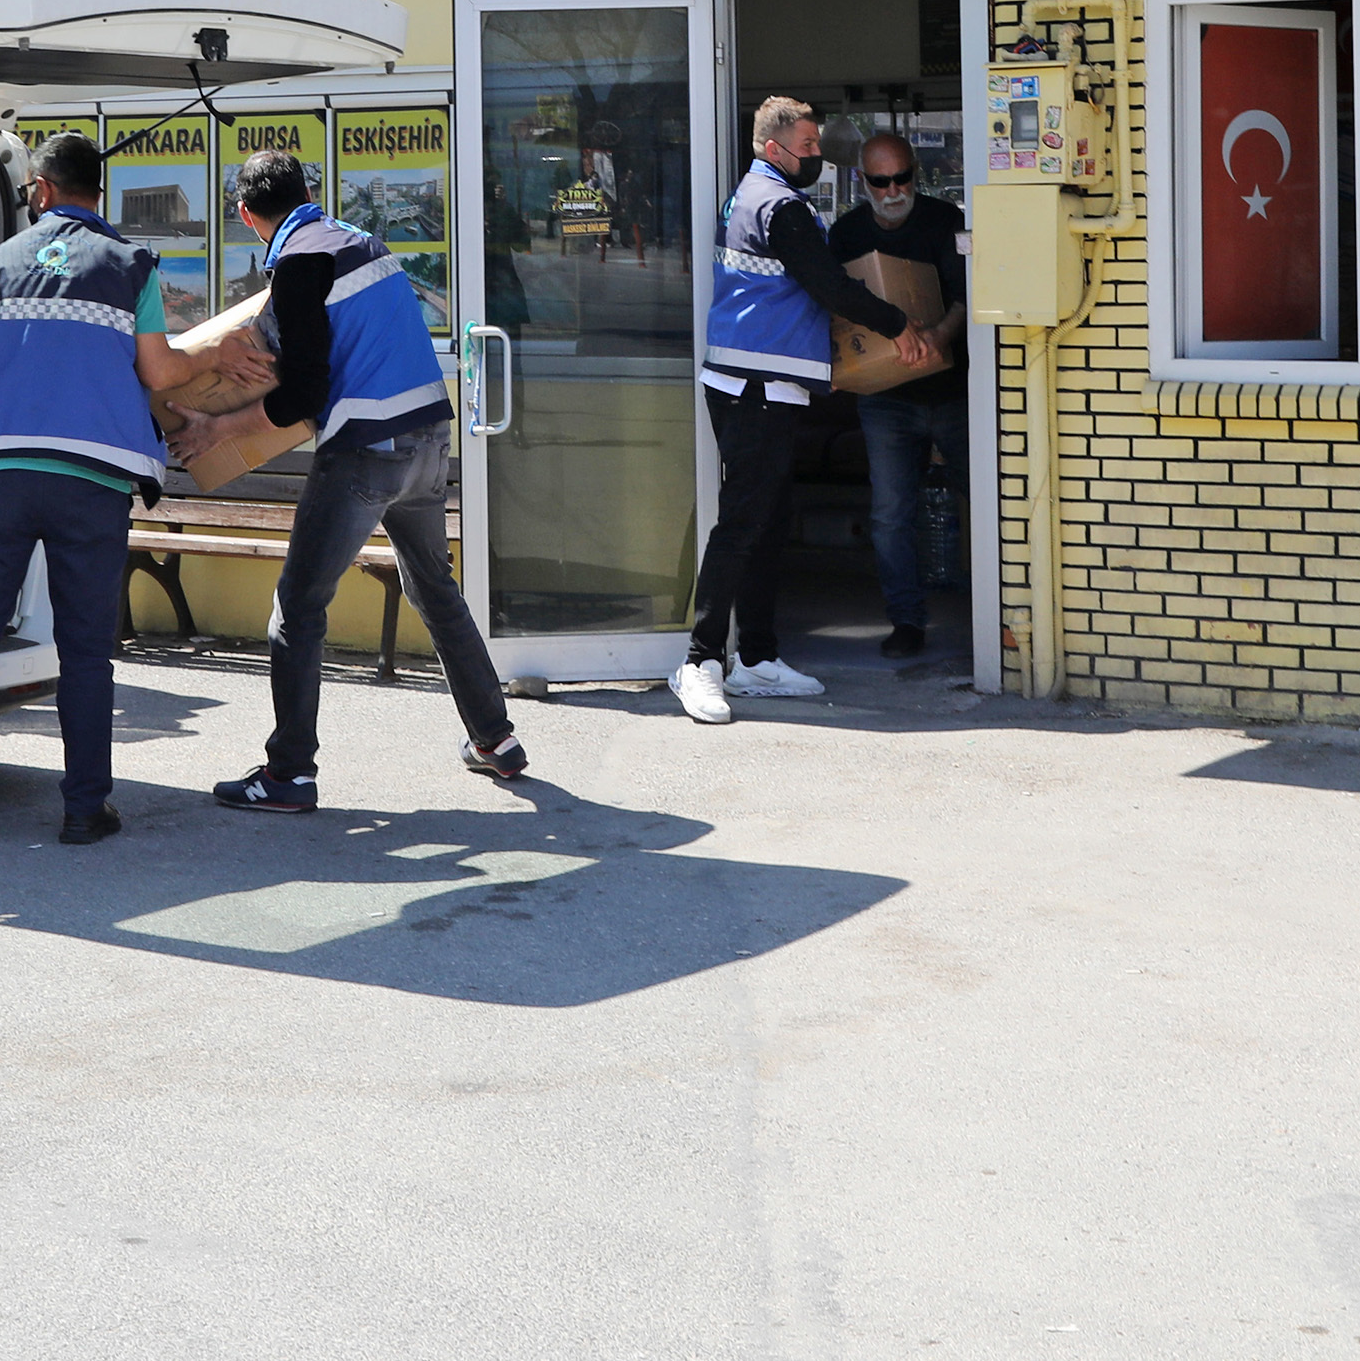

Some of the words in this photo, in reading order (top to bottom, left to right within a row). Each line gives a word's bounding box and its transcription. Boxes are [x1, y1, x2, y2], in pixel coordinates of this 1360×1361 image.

[114, 127, 206, 156] ANKARA
[238, 125, 302, 153] BURSA
[341, 119, 445, 160] ESKİŞEHİR
